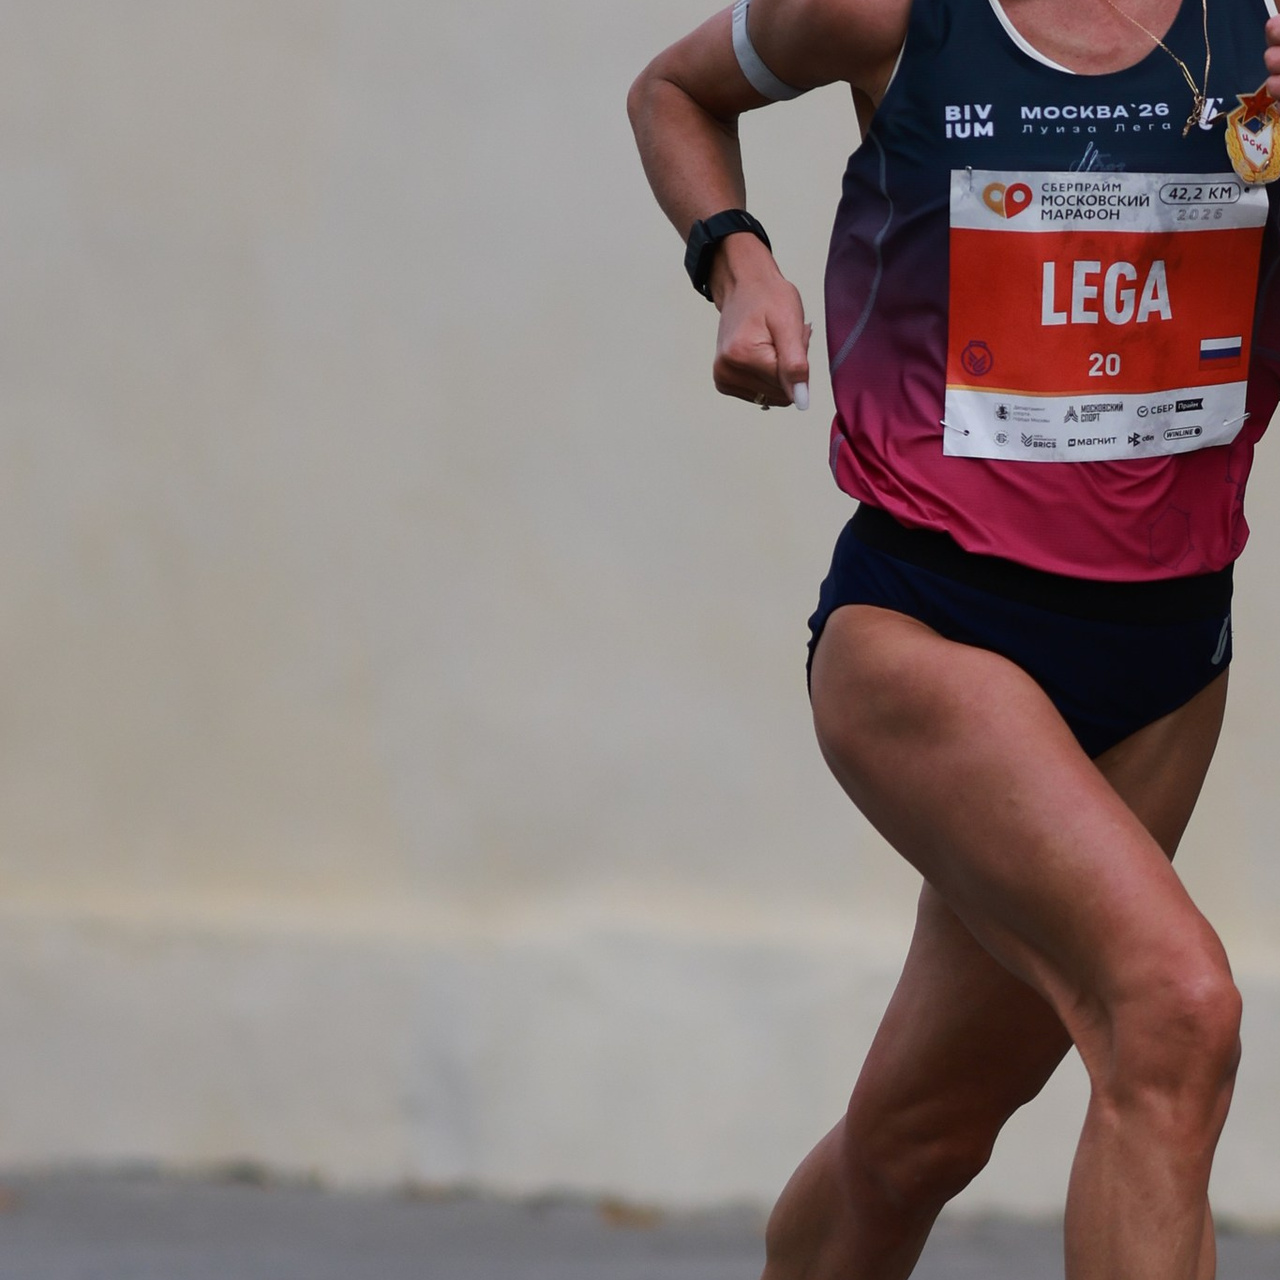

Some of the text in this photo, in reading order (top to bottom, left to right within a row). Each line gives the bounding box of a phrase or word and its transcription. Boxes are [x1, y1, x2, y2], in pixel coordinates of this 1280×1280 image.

[945, 104, 992, 121] BIV
[946, 122, 994, 138] IUM
[1022, 122, 1171, 135] Луиза Лега
[1242, 134, 1268, 154] ЦСКА
[1042, 182, 1121, 192] СБЕРПРАЙМ
[1042, 194, 1149, 207] МОСКОВСКИЙ
[1169, 187, 1202, 202] 42,2
[1042, 209, 1120, 220] МАРАФОН
[1178, 208, 1223, 221] 2026
[1042, 260, 1172, 326] LEGA
[1089, 353, 1120, 376] 20
[1081, 402, 1123, 412] МОСКОВСКИЙ
[1151, 404, 1173, 415] СБЕР
[1081, 413, 1100, 422] СПОРТ
[1166, 429, 1194, 437] WINLINE
[1078, 436, 1116, 446] магнит
